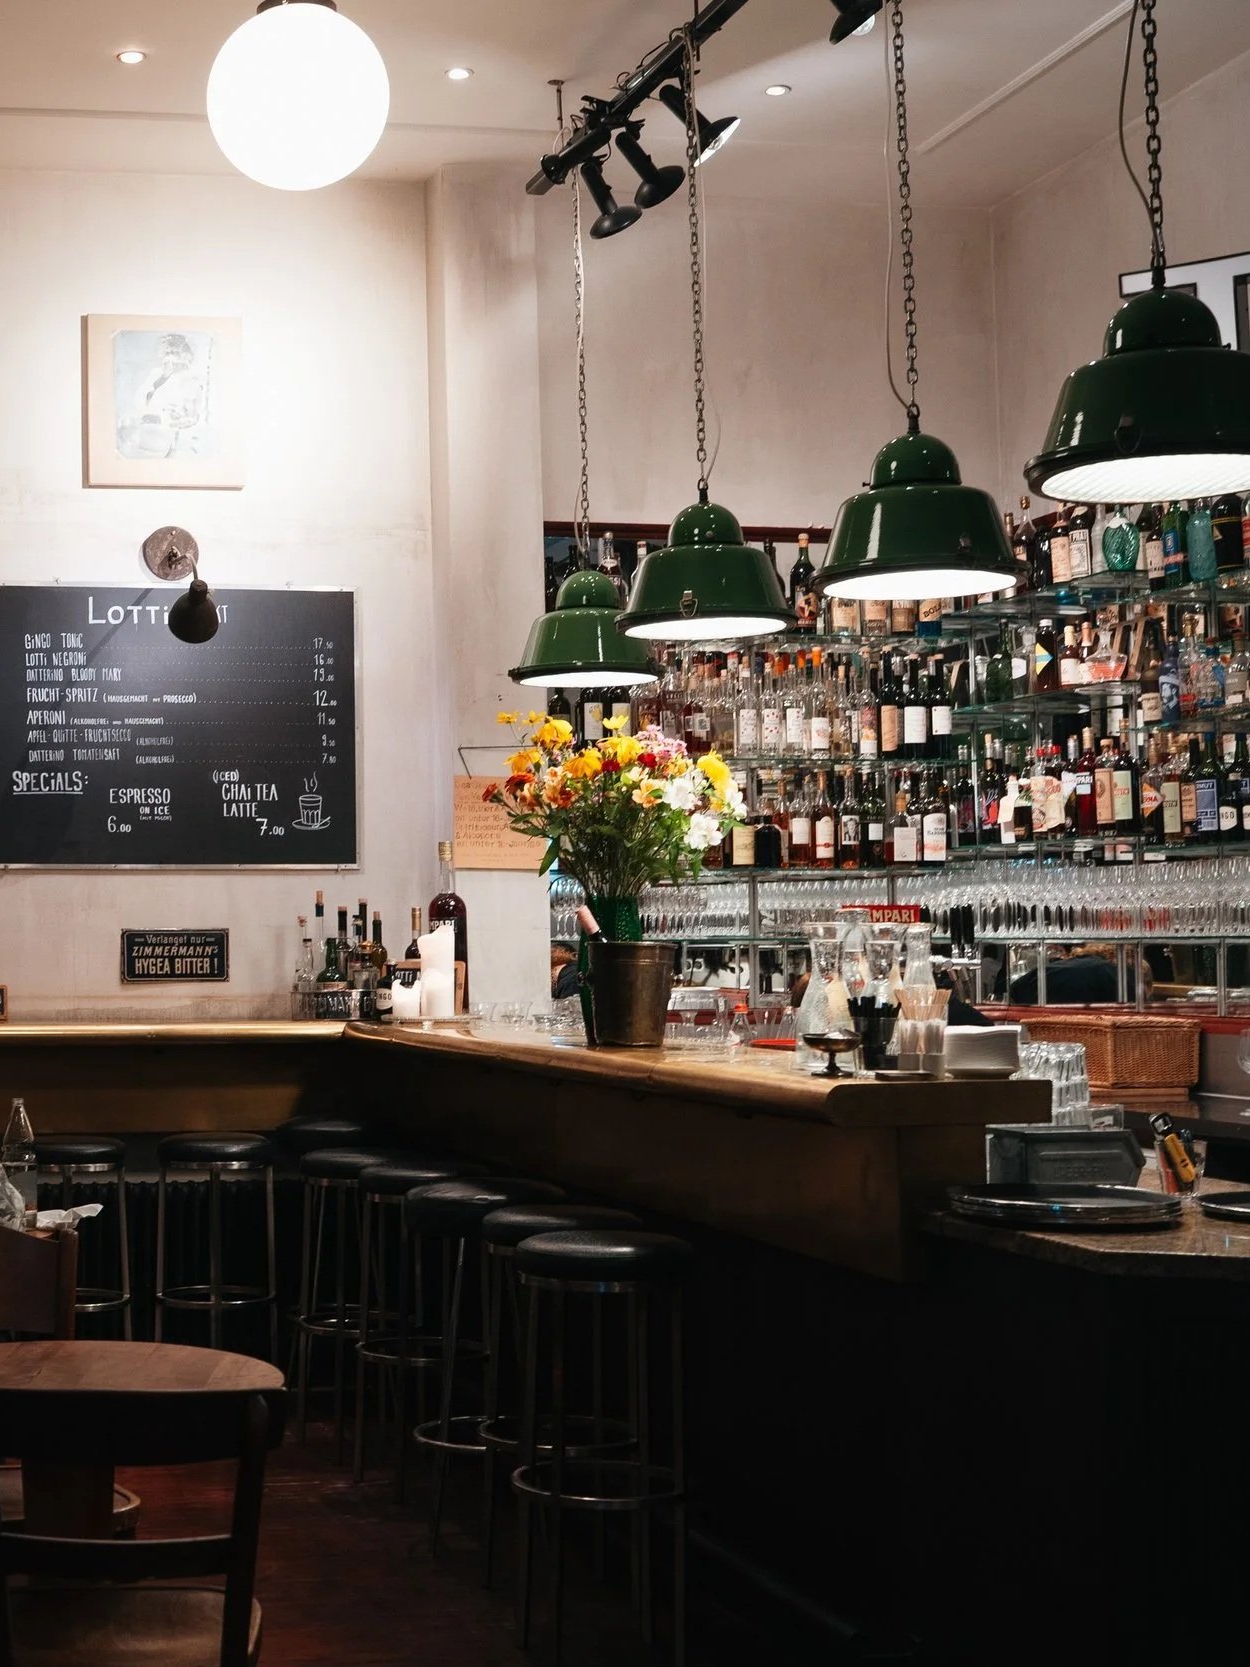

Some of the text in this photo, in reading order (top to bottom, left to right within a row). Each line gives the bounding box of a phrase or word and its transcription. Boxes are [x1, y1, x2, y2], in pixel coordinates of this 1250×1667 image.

[71, 668, 97, 681] BLOODY
[102, 668, 122, 681] MARY
[26, 710, 66, 725] APERONI
[109, 788, 171, 804] ESPRESSO
[255, 783, 279, 801] TEA
[139, 806, 170, 815] ON ICE
[223, 802, 258, 818] LATTE
[107, 815, 132, 833] 6.00
[256, 818, 285, 836] 7.00
[146, 935, 187, 945] Verlanget
[135, 958, 170, 974] HYGEA
